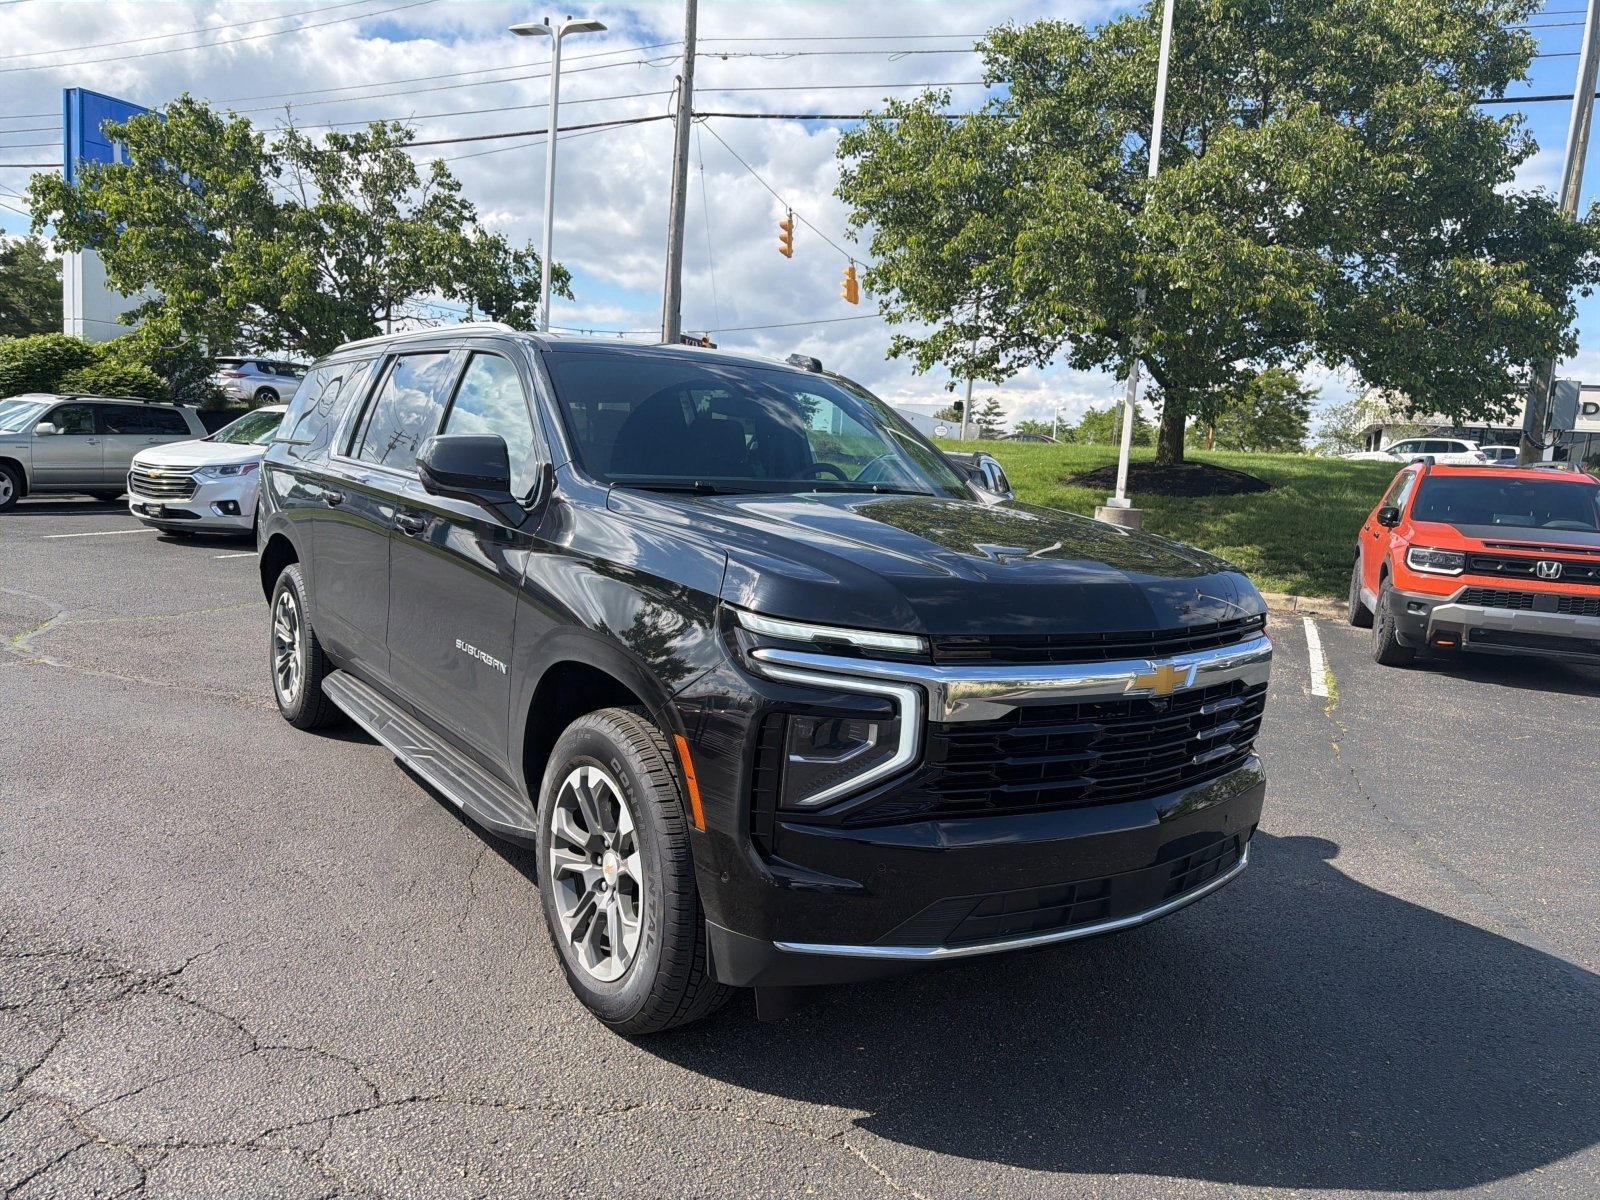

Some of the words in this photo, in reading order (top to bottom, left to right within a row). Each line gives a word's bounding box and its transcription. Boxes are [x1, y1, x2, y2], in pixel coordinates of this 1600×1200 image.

[1582, 401, 1600, 415] D
[455, 638, 508, 675] SUBURBAN
[610, 757, 656, 951] CONTIENTAL
